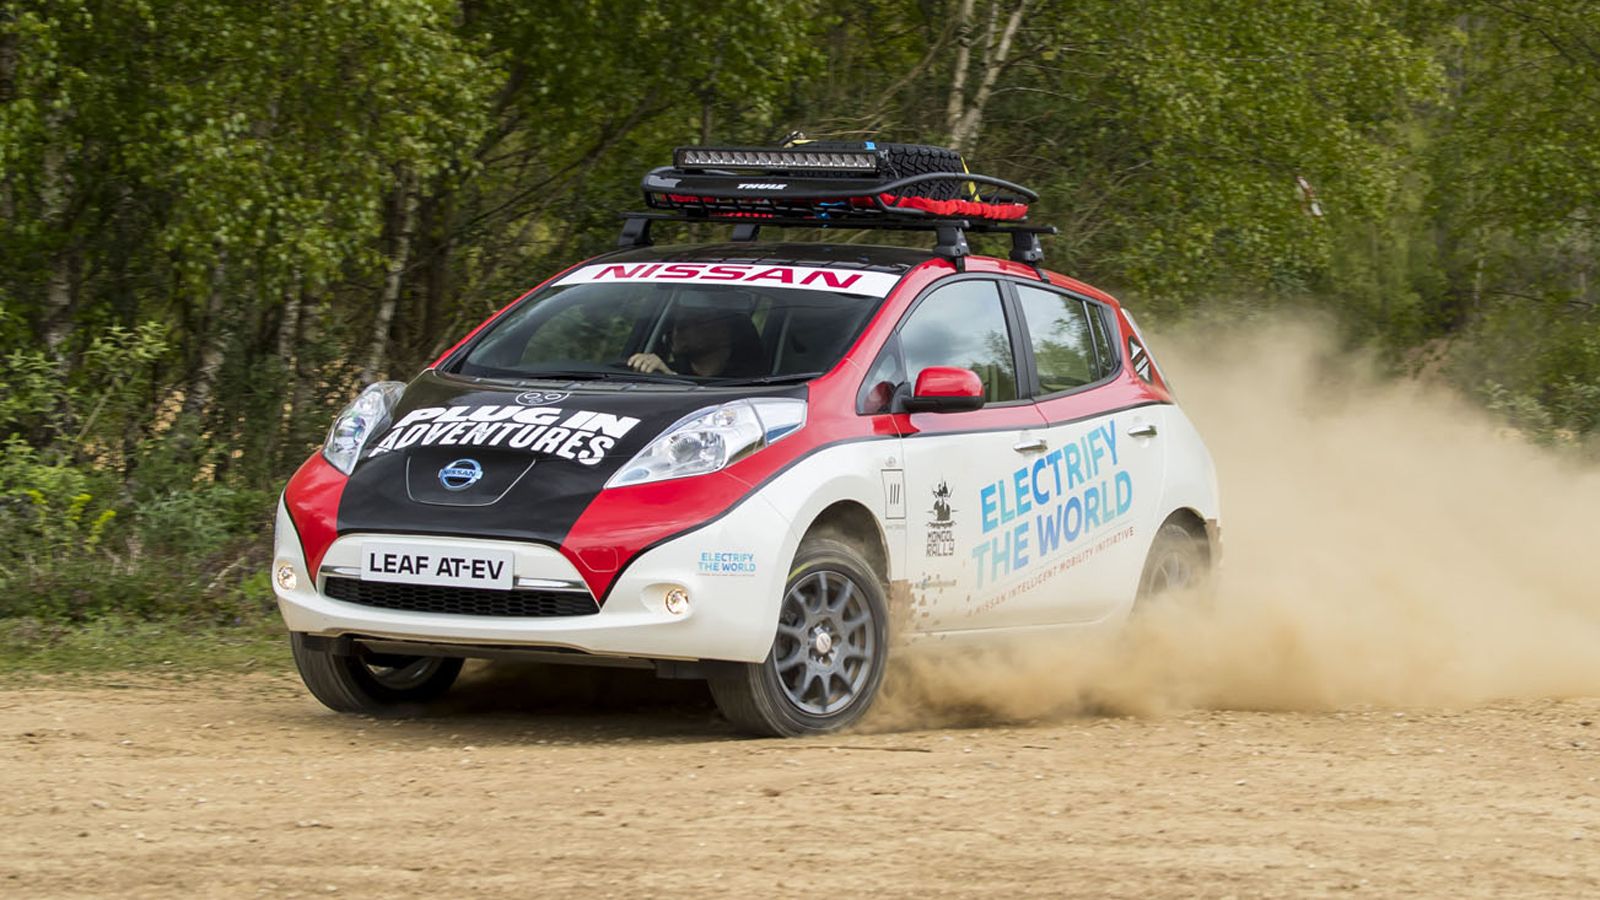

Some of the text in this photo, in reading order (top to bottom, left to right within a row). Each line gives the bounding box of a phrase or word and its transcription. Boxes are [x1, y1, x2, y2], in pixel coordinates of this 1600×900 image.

[593, 264, 862, 289] NISSAN
[392, 405, 641, 439] PLUG IN
[367, 421, 616, 466] ADVENTURES
[443, 469, 477, 477] NISSAN
[980, 420, 1118, 534] ELECTRIFY
[971, 470, 1133, 590] THE WORLD
[369, 553, 505, 580] LEAF AT-EV
[698, 561, 757, 572] THE WORLD
[701, 552, 754, 562] ELECTRIFY
